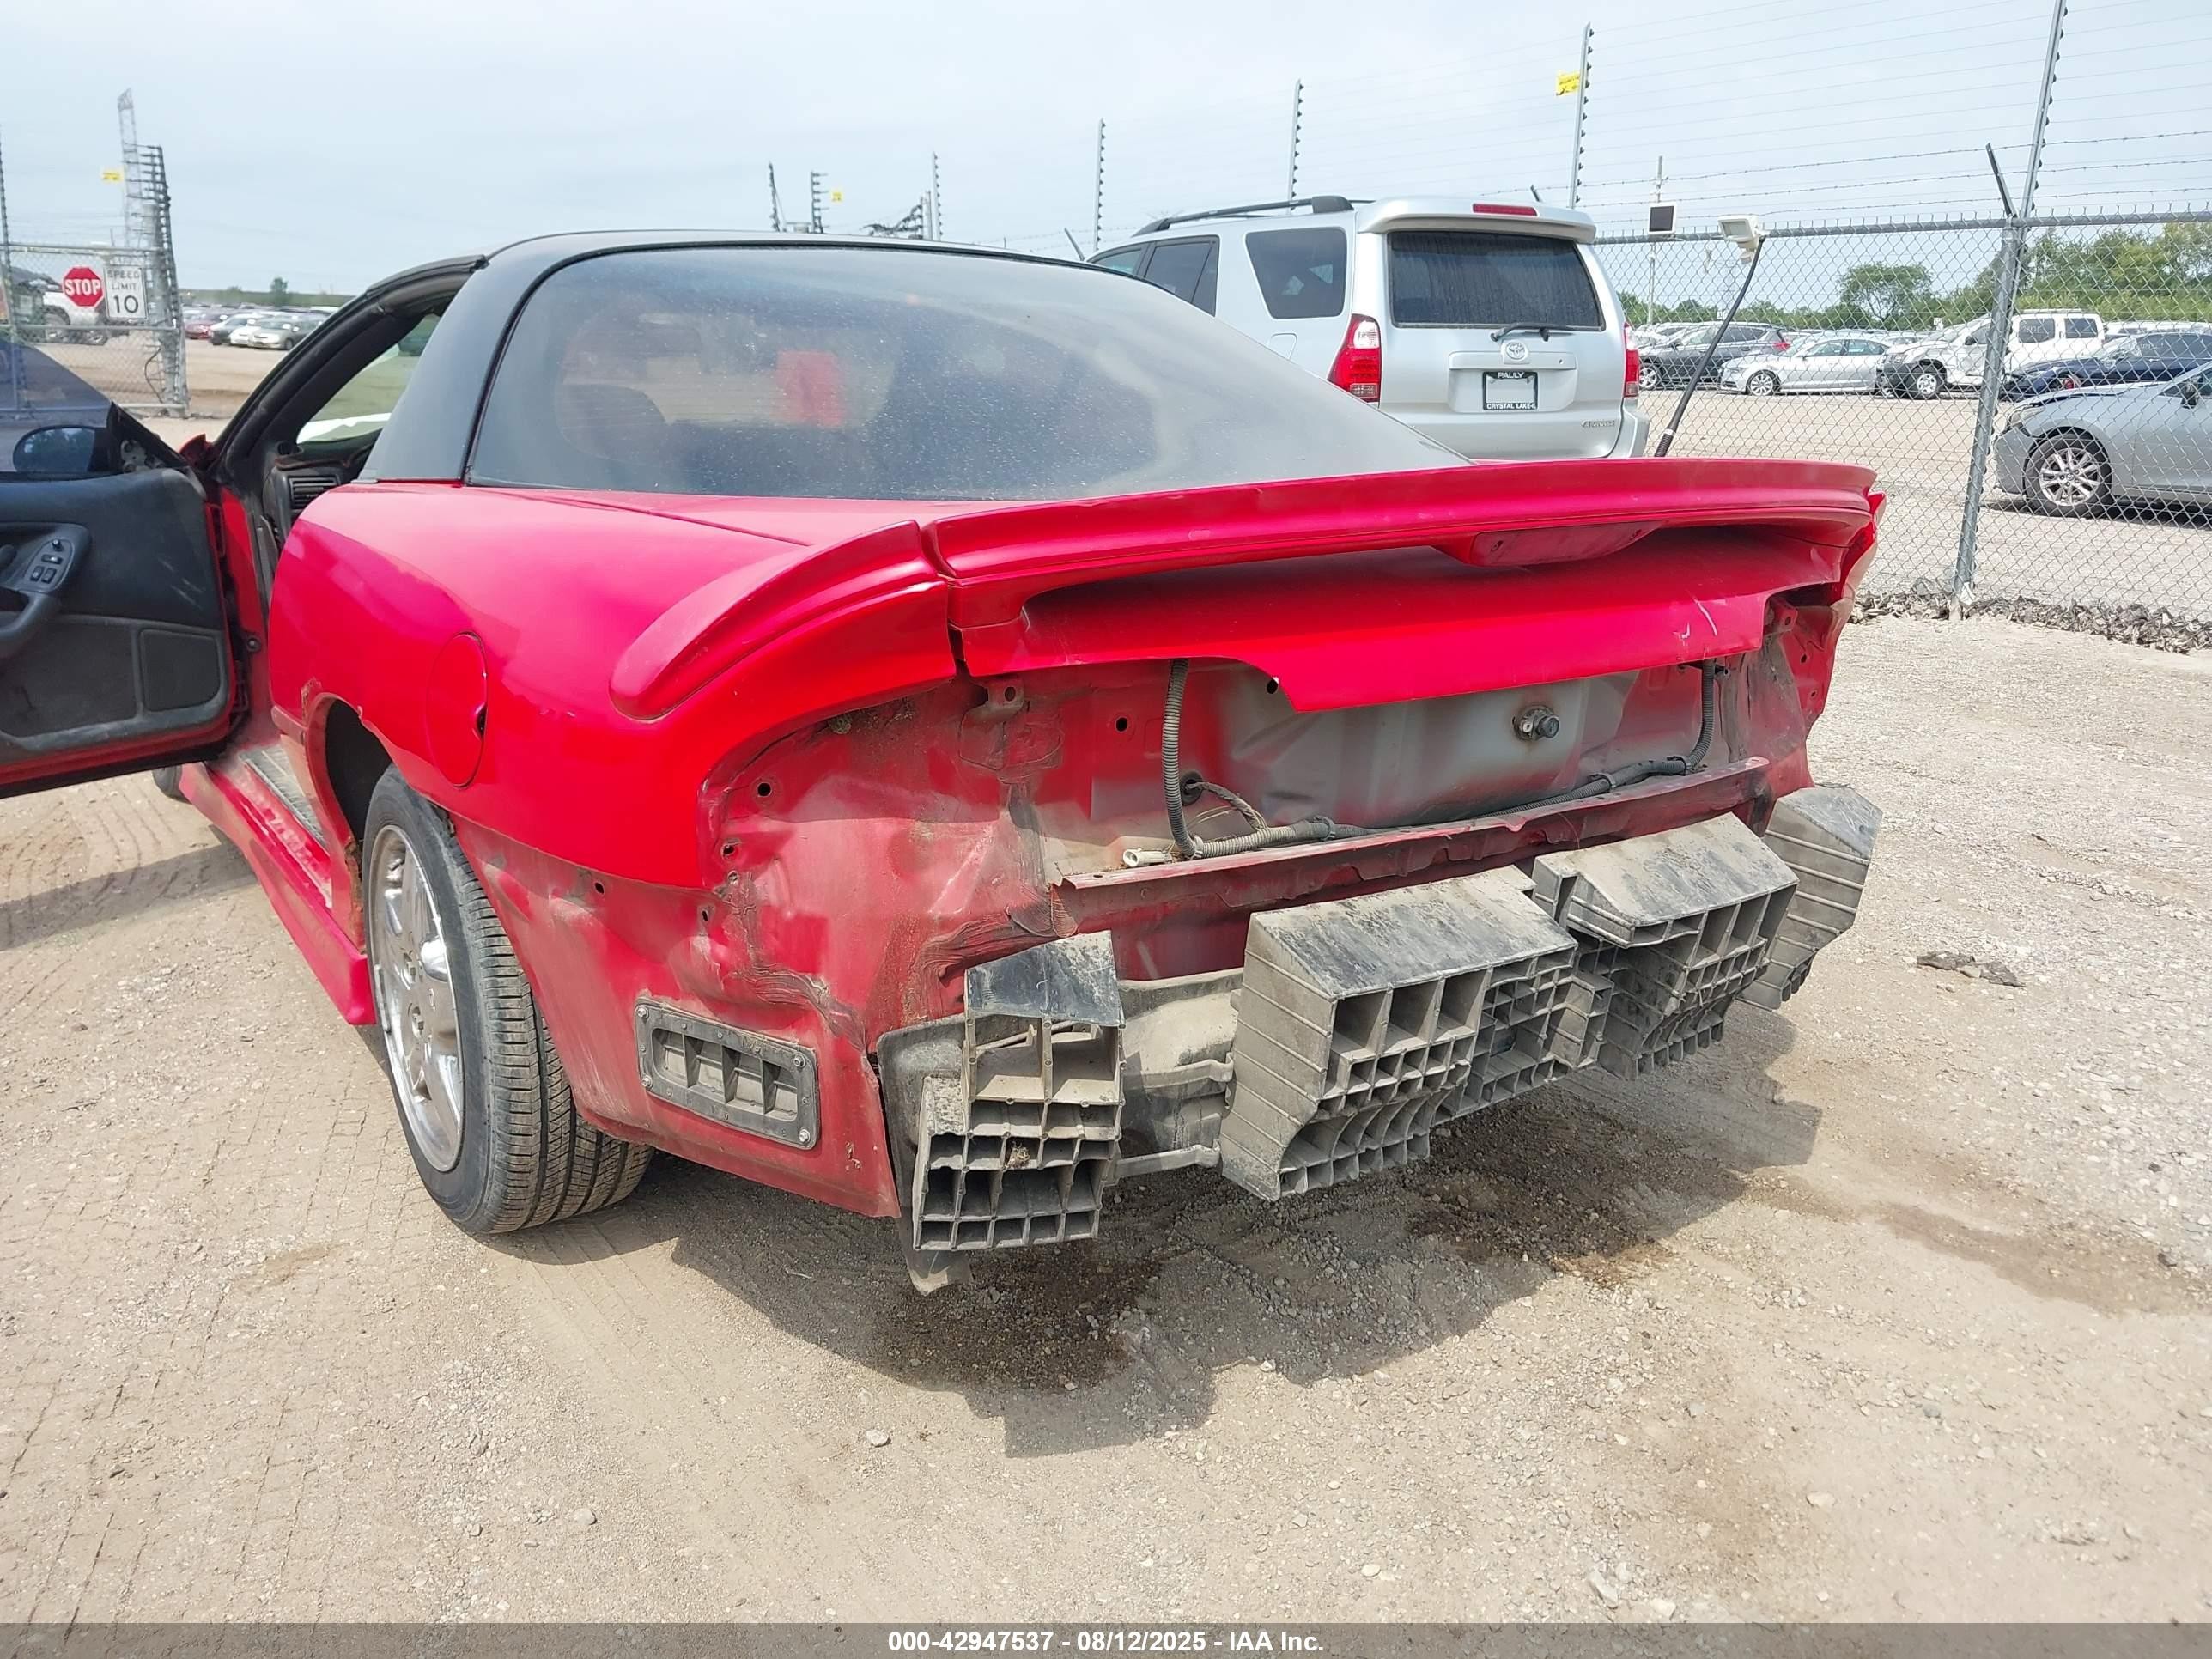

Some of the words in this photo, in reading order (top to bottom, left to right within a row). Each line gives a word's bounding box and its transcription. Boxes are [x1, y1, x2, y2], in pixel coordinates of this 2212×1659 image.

[107, 270, 139, 279] SPEED
[64, 278, 101, 295] STOP
[113, 295, 139, 313] 10
